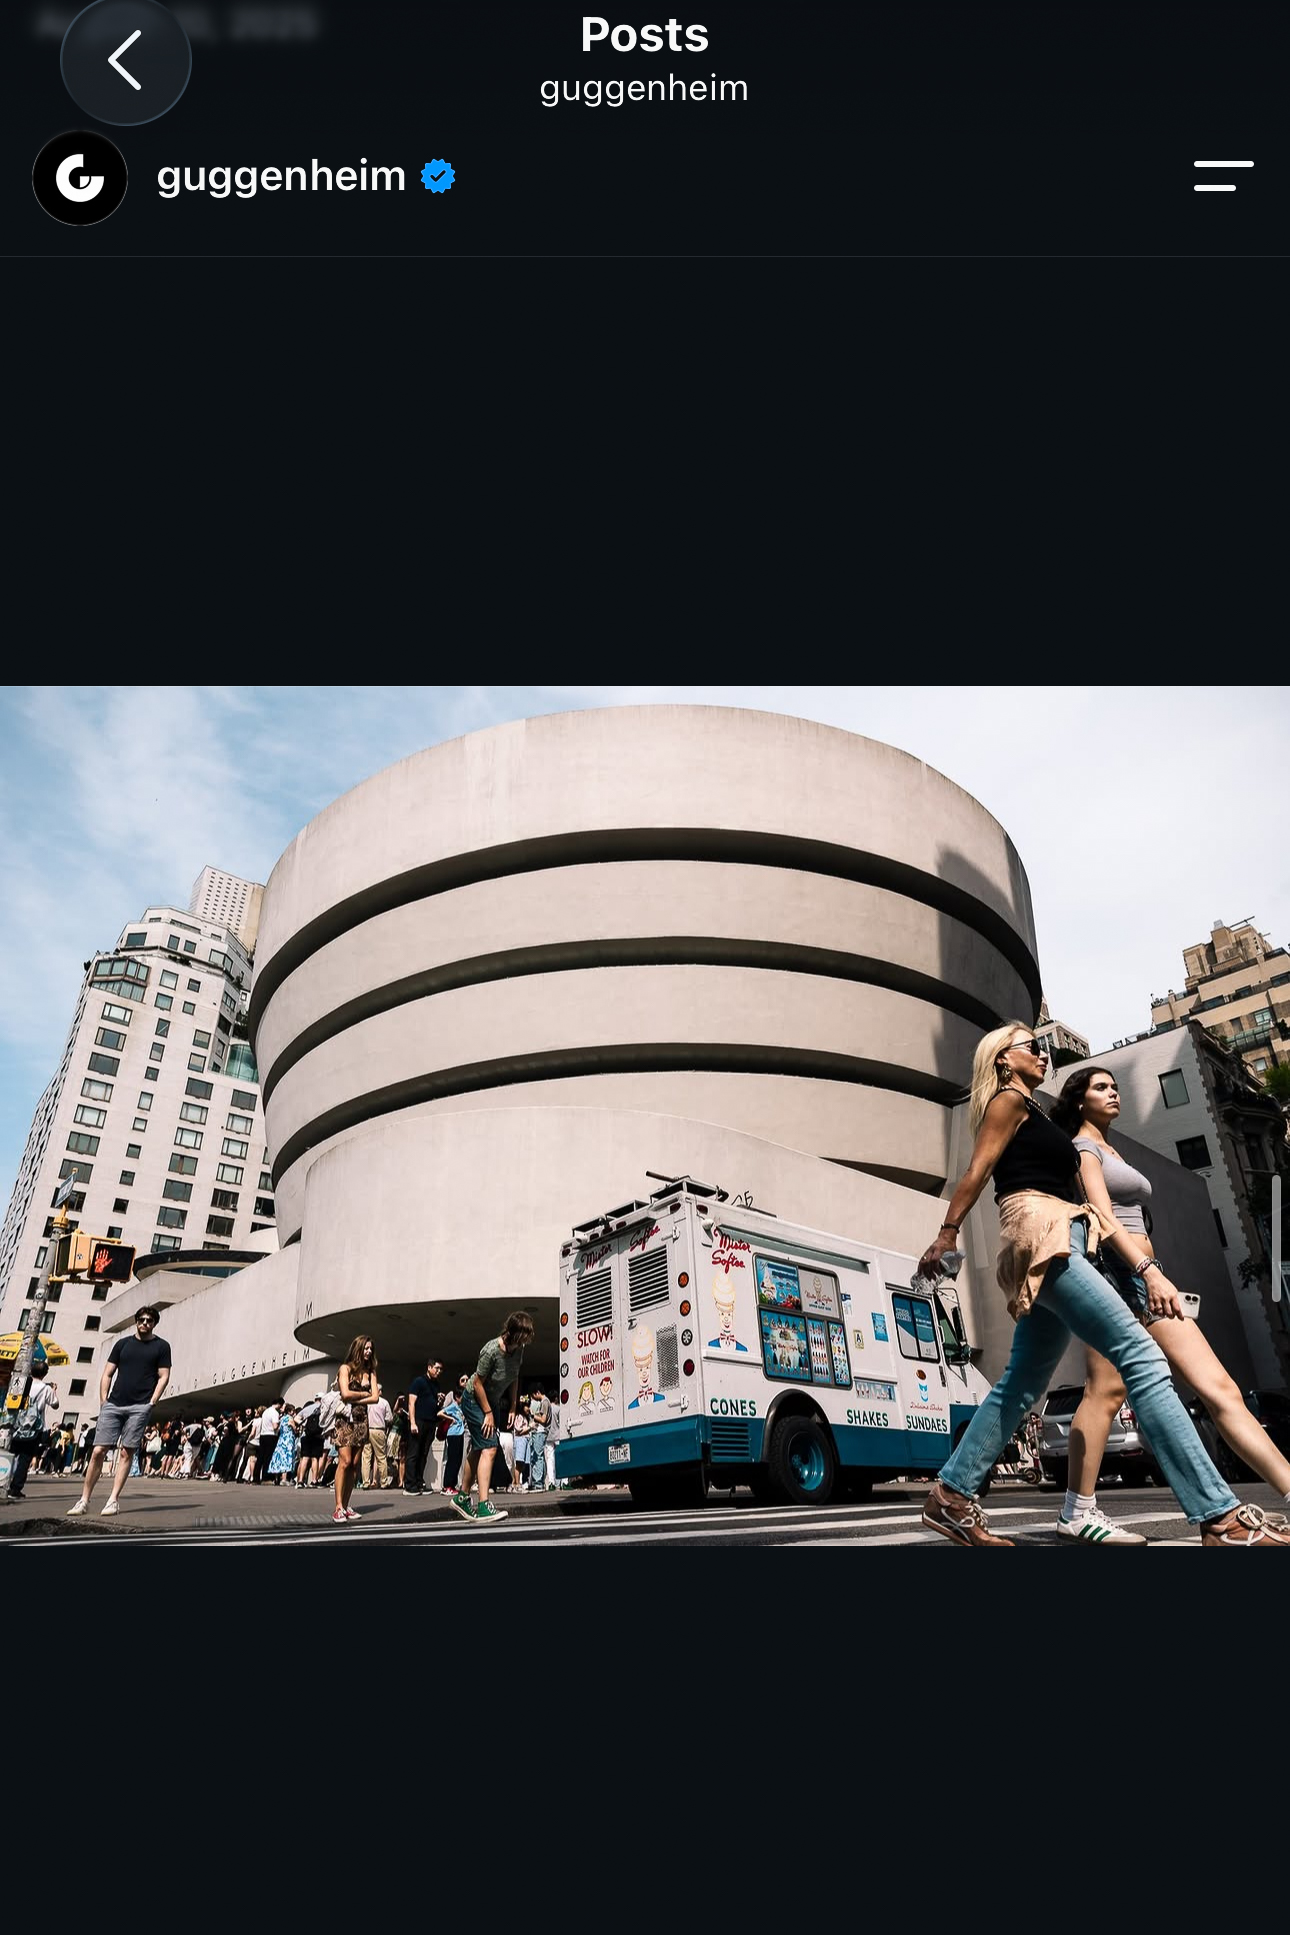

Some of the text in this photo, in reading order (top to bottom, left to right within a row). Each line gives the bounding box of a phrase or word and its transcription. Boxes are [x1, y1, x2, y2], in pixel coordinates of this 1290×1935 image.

[580, 1225, 660, 1270] Mister Softee
[713, 1226, 751, 1253] Mister
[711, 1249, 745, 1274] Softee
[577, 1325, 613, 1348] SLOW!
[212, 1348, 310, 1385] GUGGENHEIM
[581, 1348, 611, 1366] WATCH FOR
[577, 1359, 615, 1379] OUR CHILDREN
[710, 1397, 757, 1417] CONES
[846, 1408, 889, 1427] SHAKES
[905, 1414, 948, 1432] SUNDAES
